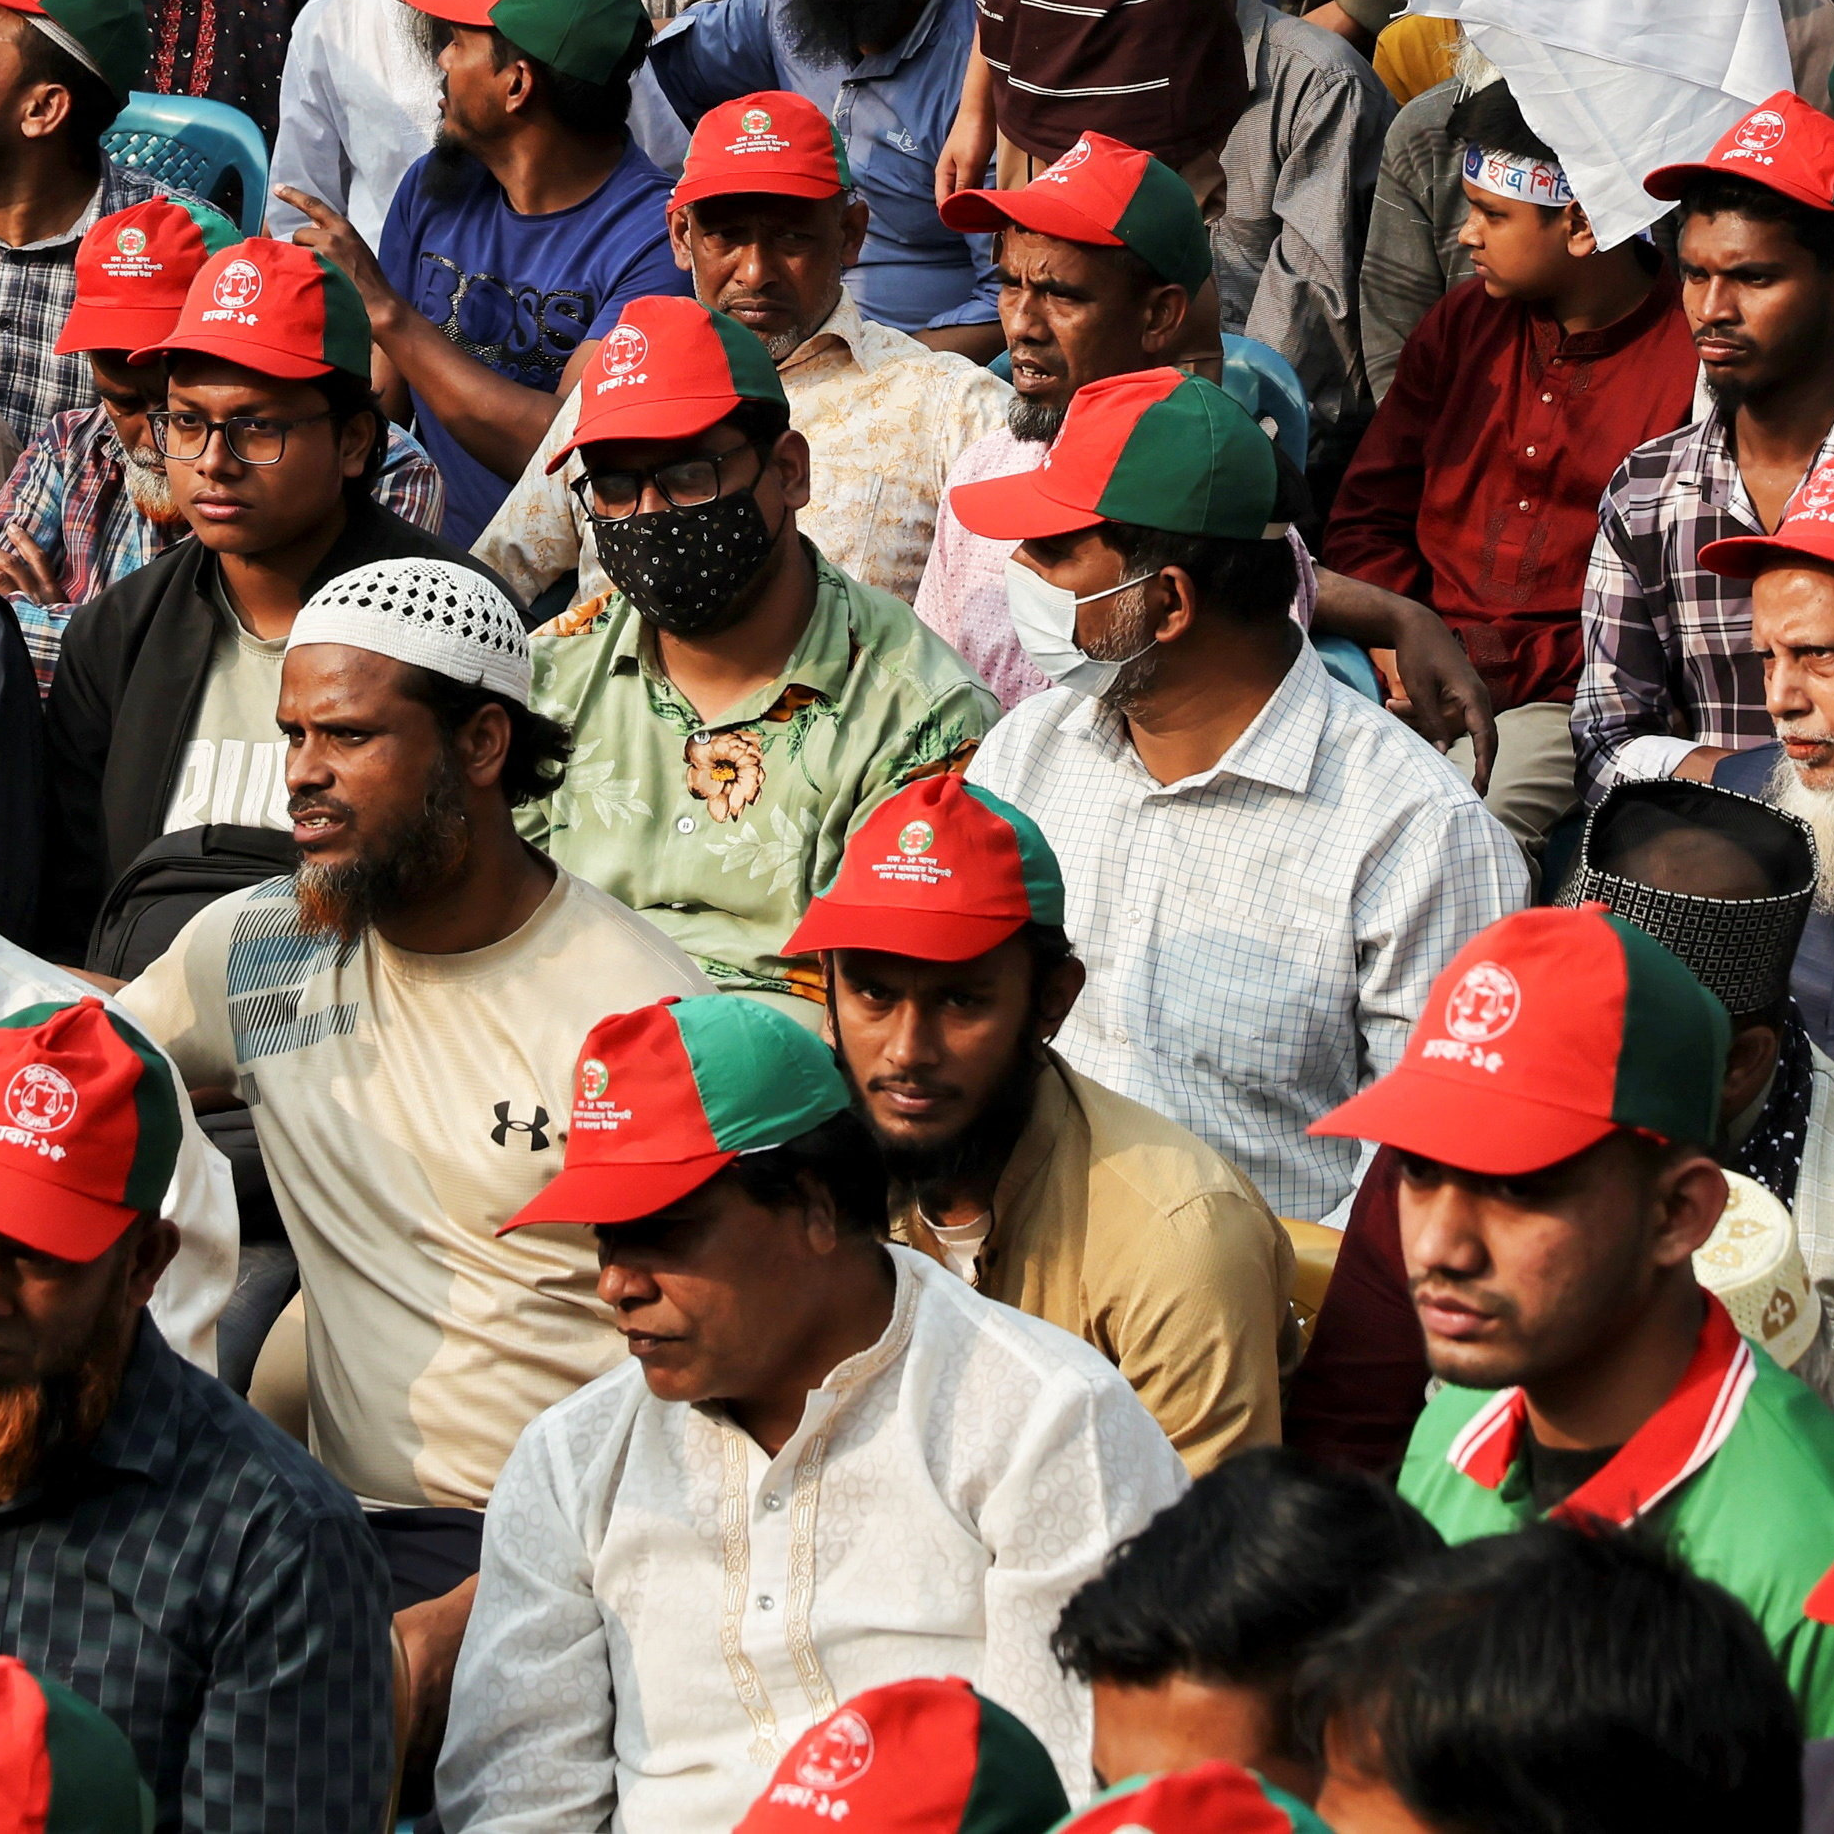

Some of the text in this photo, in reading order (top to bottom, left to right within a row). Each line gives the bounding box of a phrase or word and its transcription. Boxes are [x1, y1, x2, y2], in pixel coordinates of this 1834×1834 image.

[1721, 149, 1773, 166] ঢাকা-১৫
[1487, 159, 1522, 189] ছাত্র
[419, 252, 592, 358] BOSS
[201, 309, 259, 325] ঢাকা-১৫
[596, 374, 648, 395] ঢাকা-১৫
